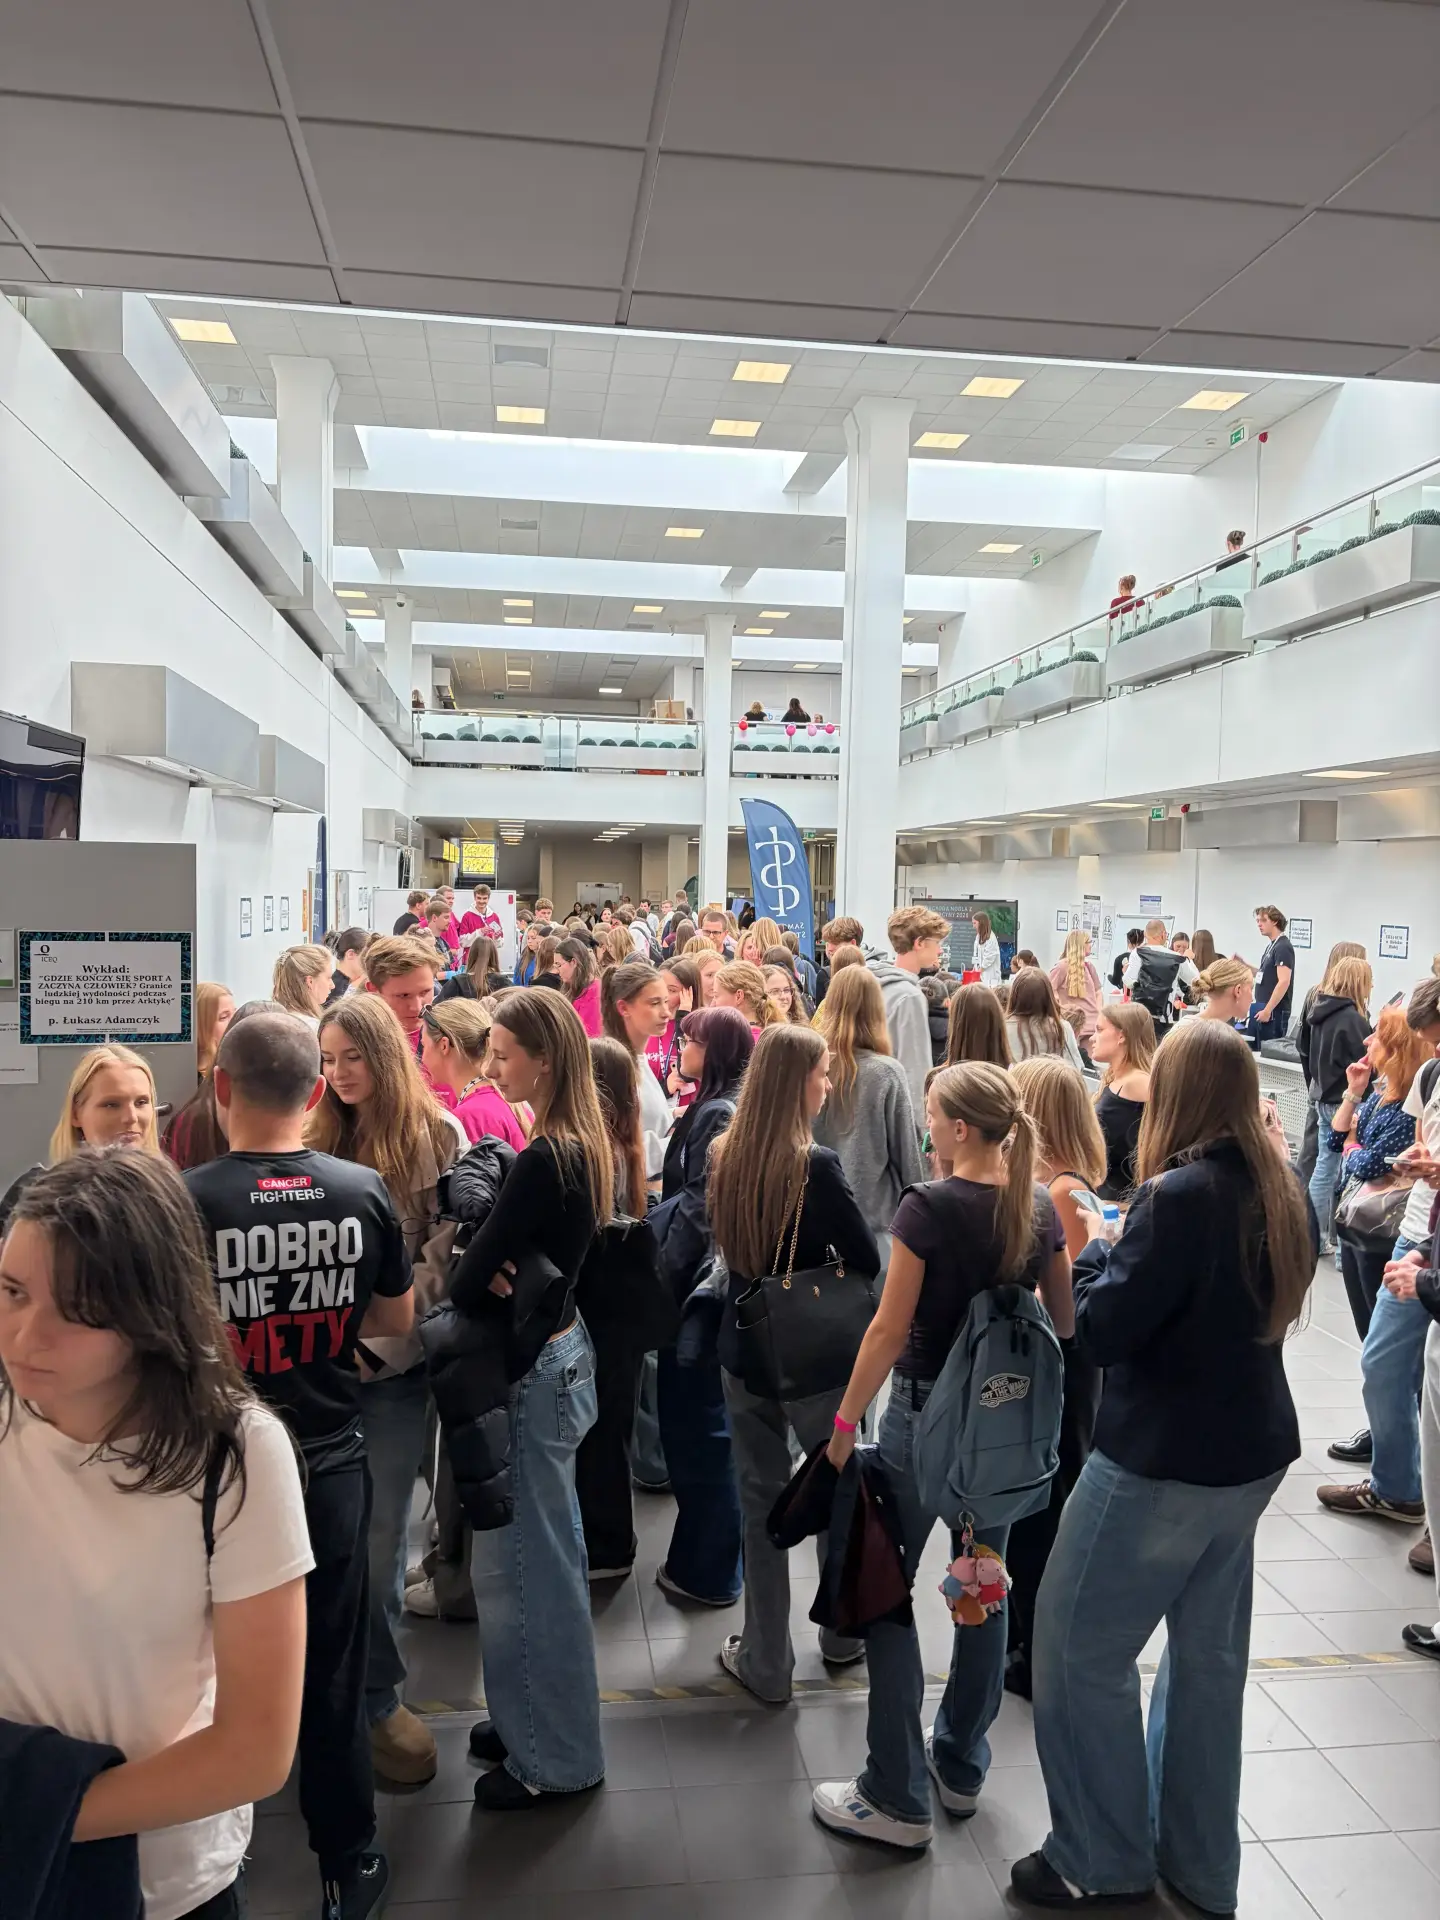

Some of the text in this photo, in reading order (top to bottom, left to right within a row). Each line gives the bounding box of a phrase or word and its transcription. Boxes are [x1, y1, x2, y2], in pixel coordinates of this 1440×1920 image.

[82, 964, 130, 975] Wykład:
[116, 975, 131, 983] SIĘ
[44, 990, 167, 998] ludzkiej wydolności podczas
[35, 998, 61, 1006] biegu
[112, 998, 135, 1006] przez
[48, 1015, 160, 1026] p. Łukasz Adamczyk
[262, 1177, 308, 1189] CANCER
[250, 1187, 326, 1204] FIGHTERS
[215, 1216, 364, 1279] DOBRO
[219, 1267, 356, 1323] NIE ZNA
[988, 1376, 1009, 1390] VANS
[981, 1390, 994, 1399] OFF
[993, 1385, 1009, 1398] THE
